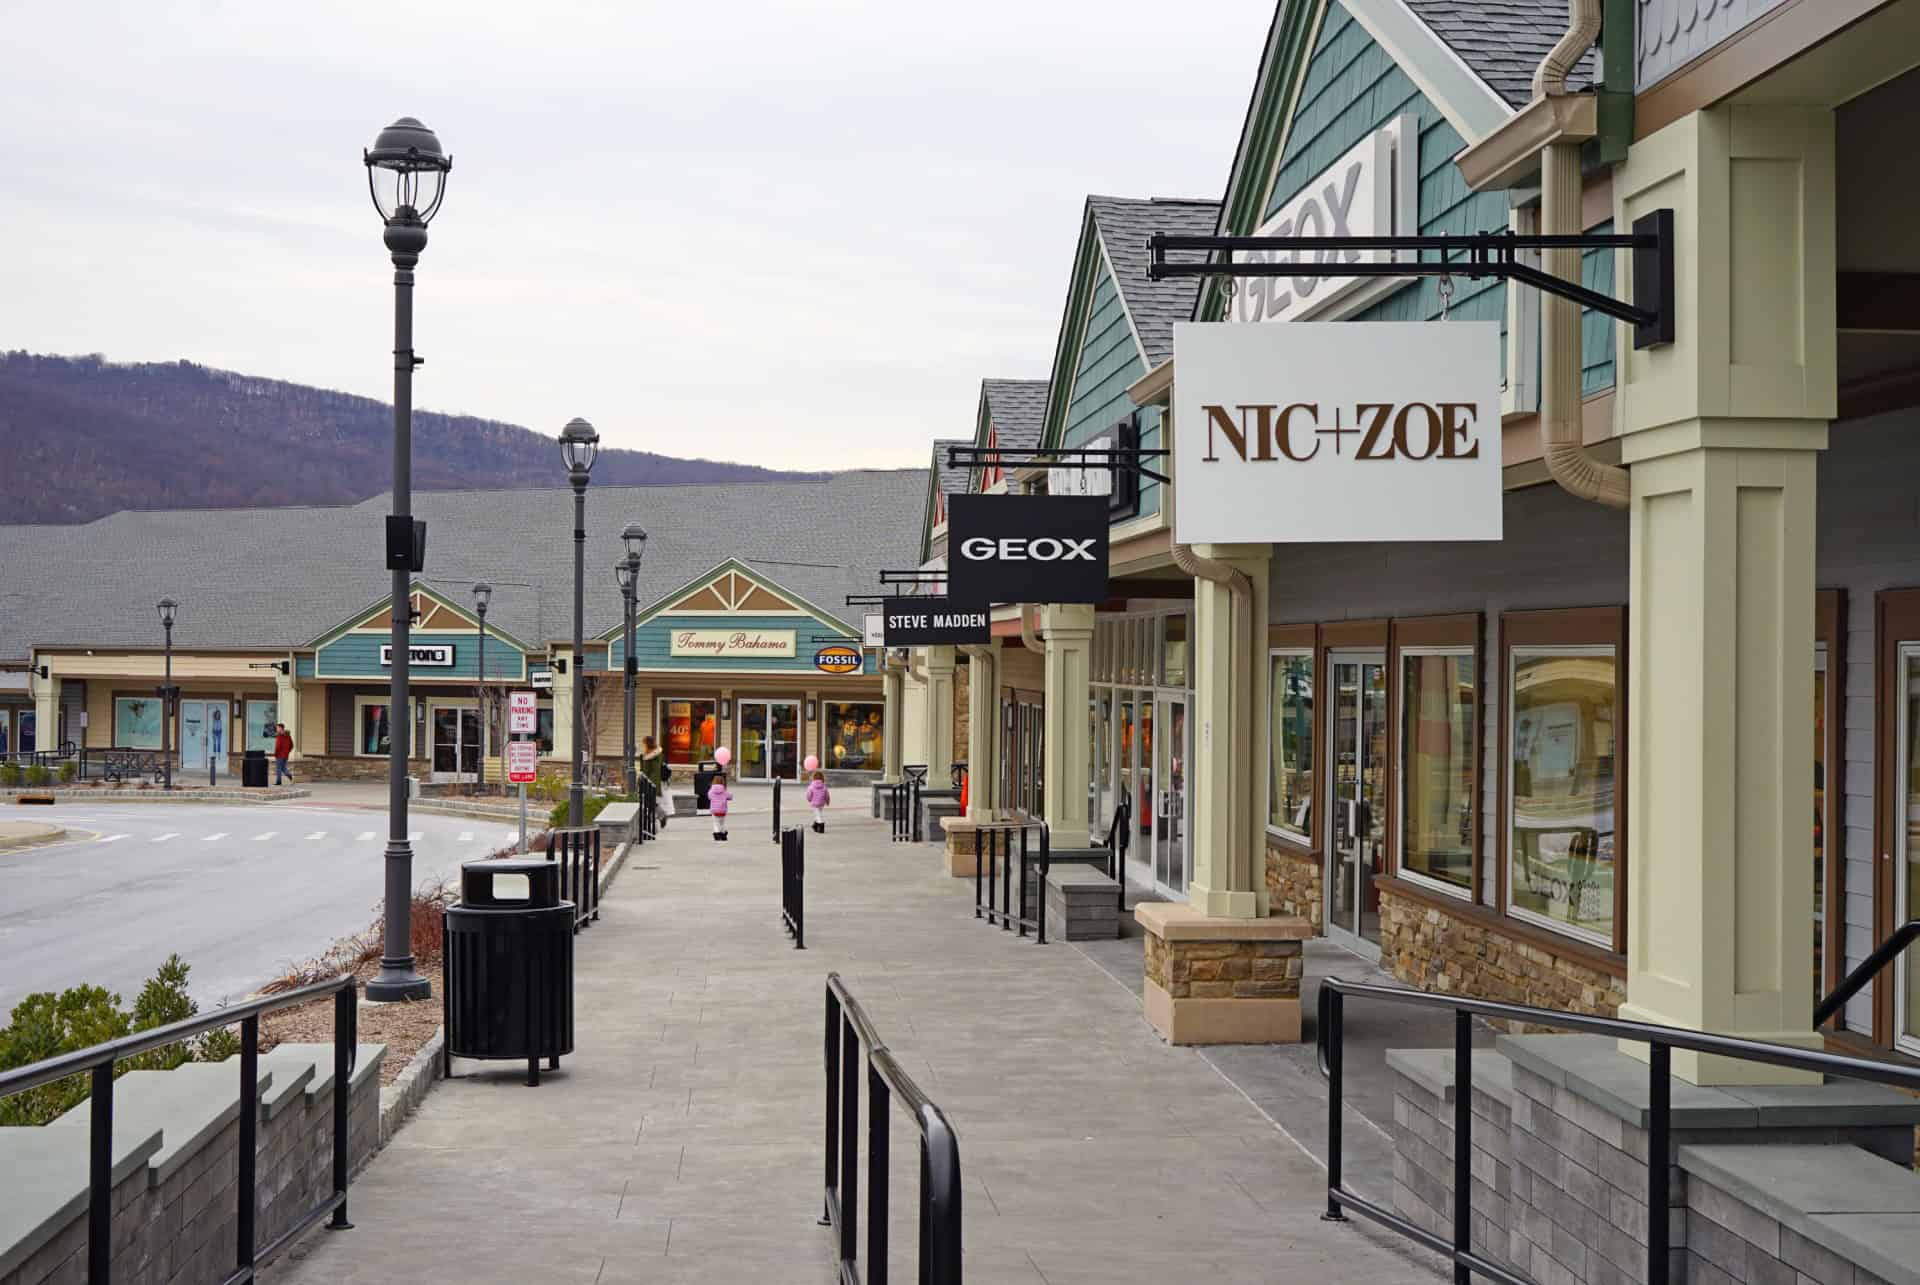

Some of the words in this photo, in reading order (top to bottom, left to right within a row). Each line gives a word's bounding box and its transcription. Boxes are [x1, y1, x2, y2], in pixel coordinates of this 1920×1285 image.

[1239, 162, 1362, 321] GEOX
[1201, 402, 1480, 462] NIC+ZOE
[961, 537, 1097, 561] GEOX
[889, 615, 928, 629] STEVE
[933, 614, 986, 628] MADDEN
[677, 632, 726, 655] Tommy
[728, 632, 788, 649] Bahama
[818, 655, 858, 665] FOSSIL
[517, 695, 528, 705] NO
